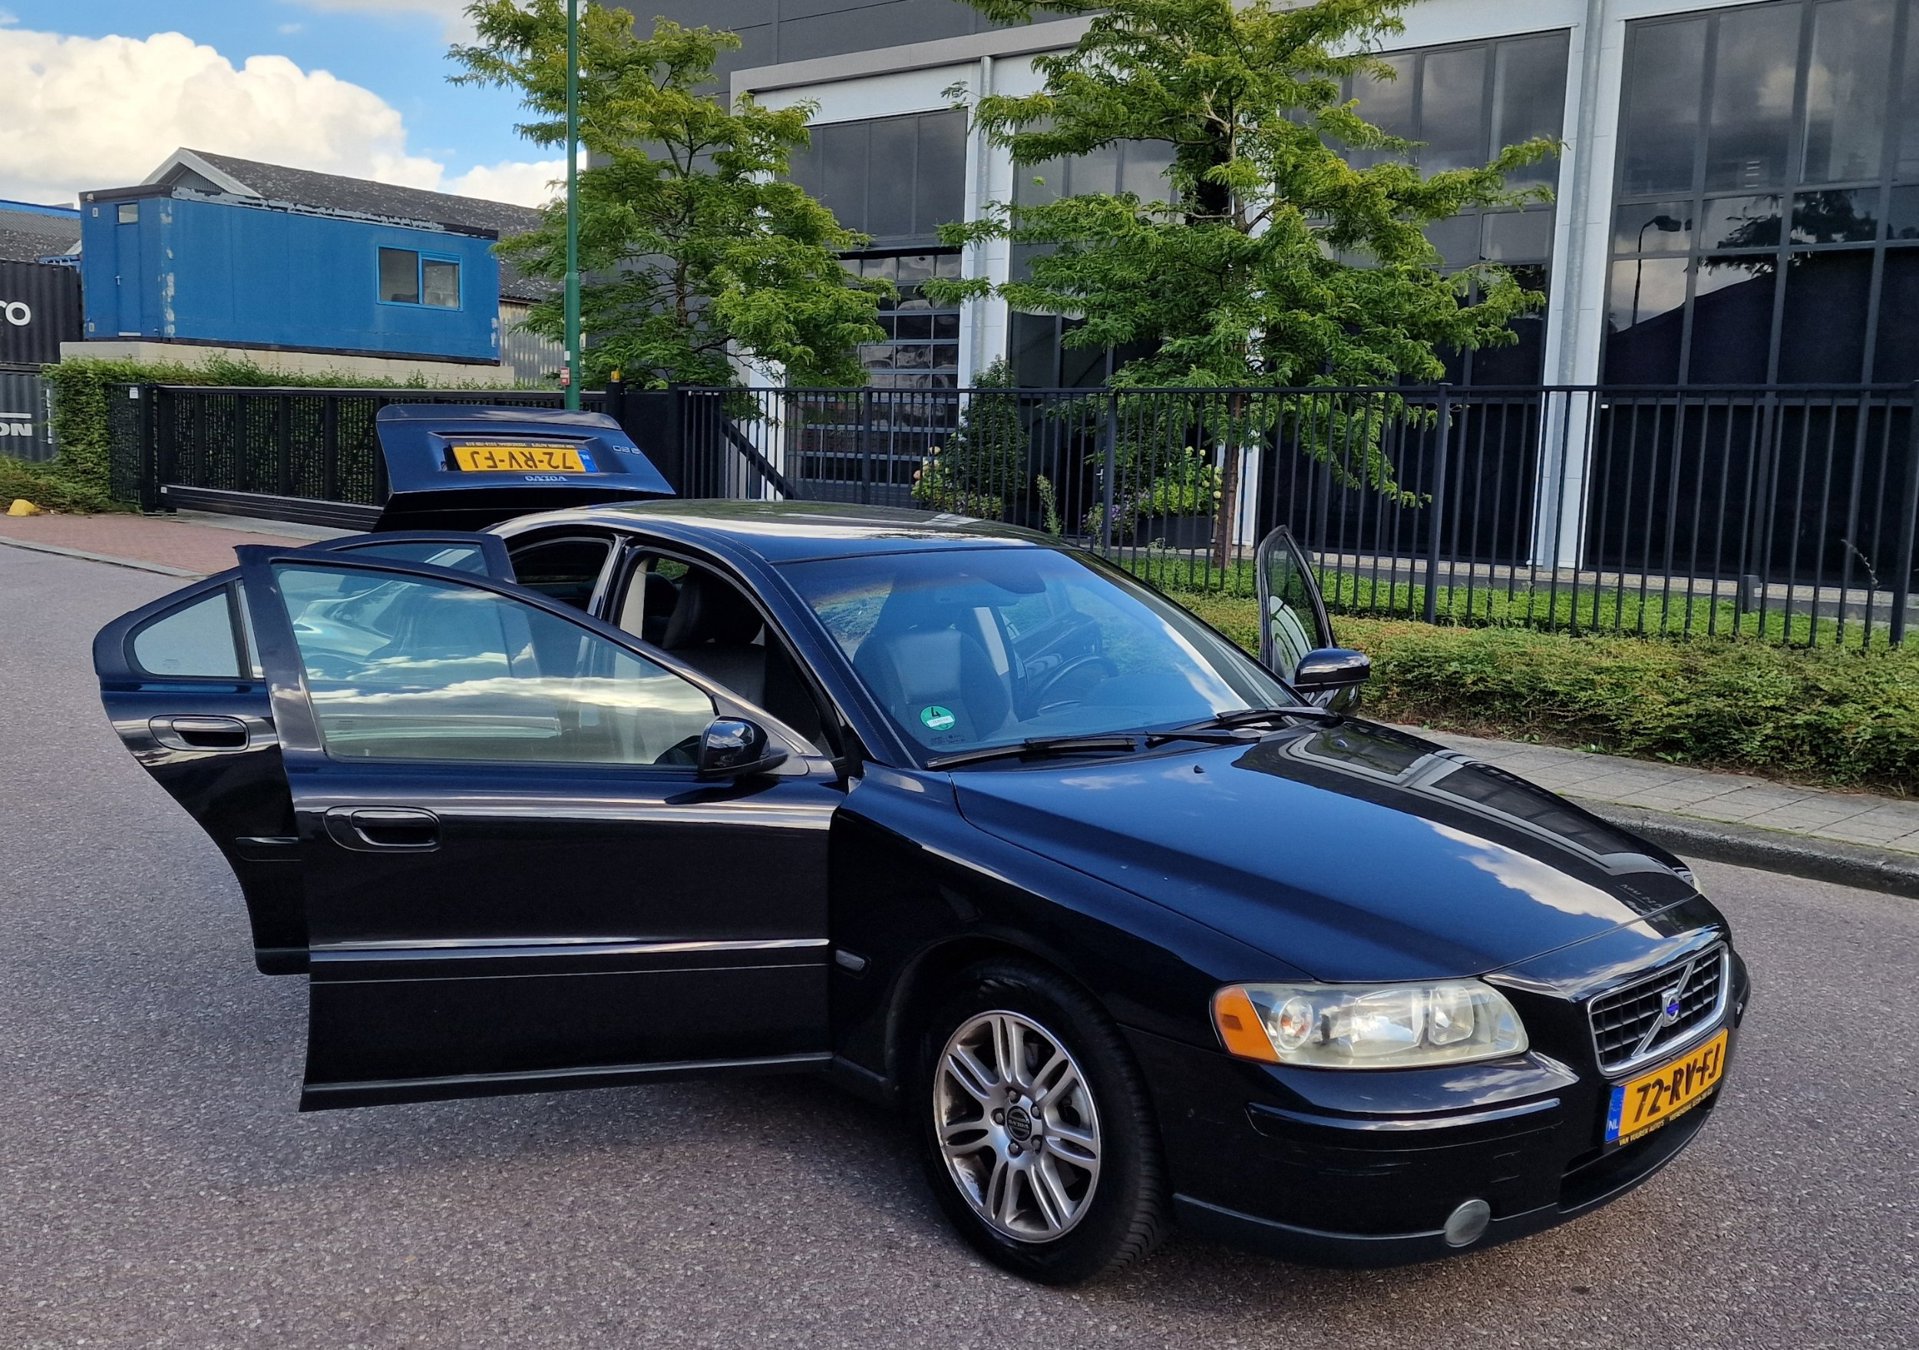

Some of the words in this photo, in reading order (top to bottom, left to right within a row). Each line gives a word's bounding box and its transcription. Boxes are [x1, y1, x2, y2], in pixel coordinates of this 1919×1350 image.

[470, 450, 575, 469] 72-RV-FJ
[930, 706, 941, 718] 4
[1633, 1042, 1721, 1123] 72-RV-FJ
[1608, 1118, 1619, 1131] NL
